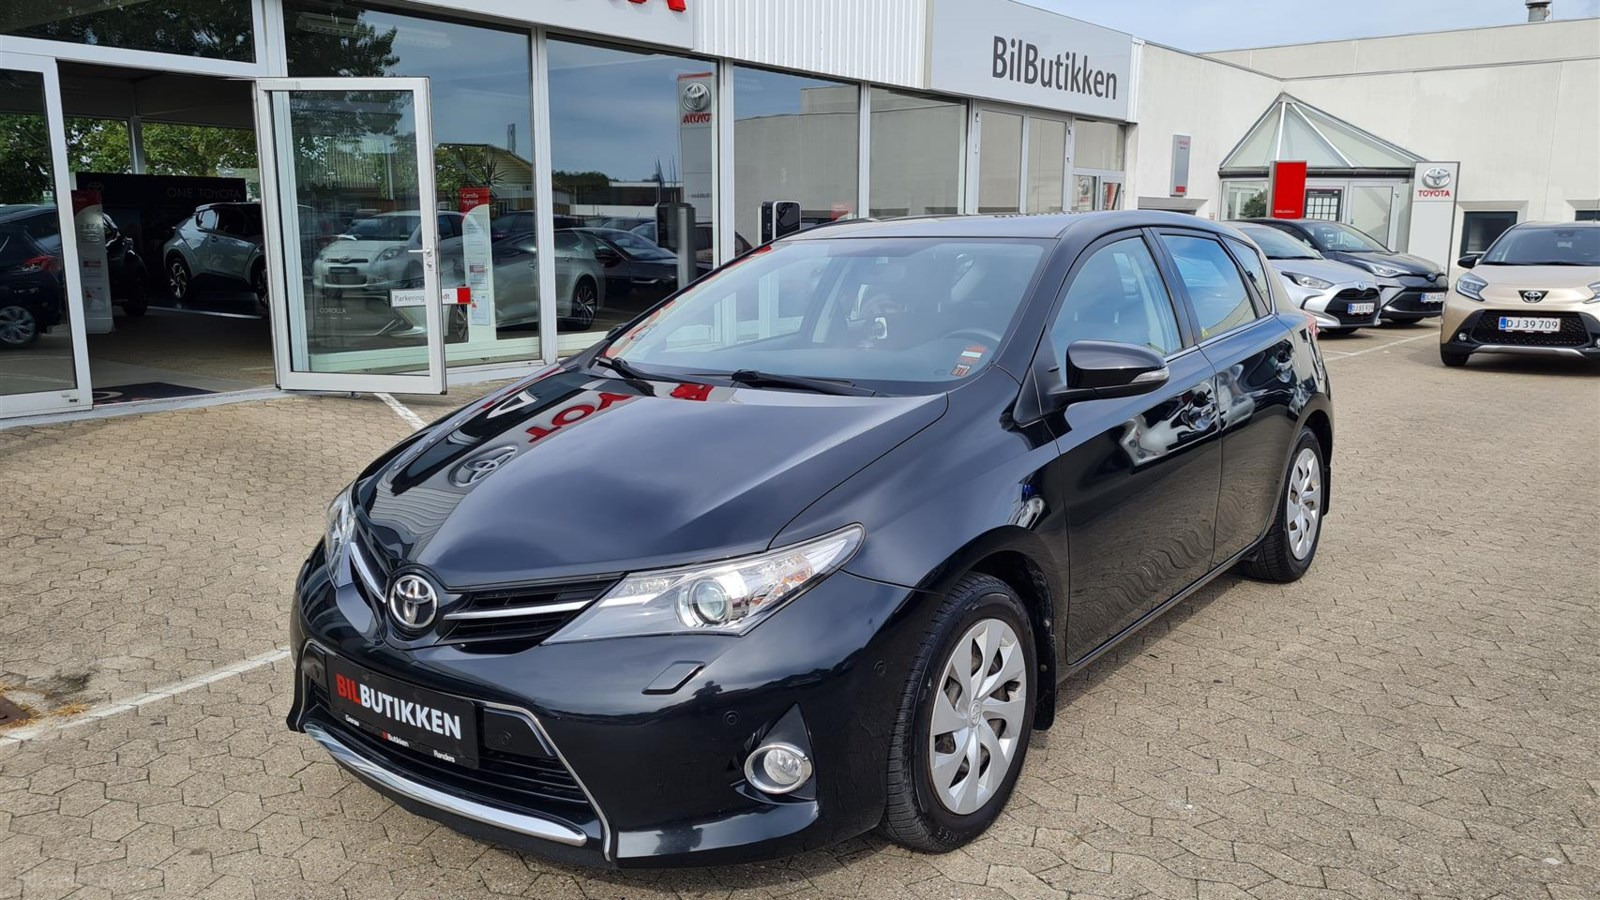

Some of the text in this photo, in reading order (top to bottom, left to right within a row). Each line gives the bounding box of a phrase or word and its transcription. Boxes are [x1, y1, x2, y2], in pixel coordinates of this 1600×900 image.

[992, 35, 1117, 100] BilButikken
[394, 295, 425, 303] Parkering
[319, 307, 347, 315] COROLLA
[1506, 319, 1558, 329] DJ 39 709
[335, 673, 462, 740] BILBUTIKKEN
[433, 749, 456, 763] Randers
